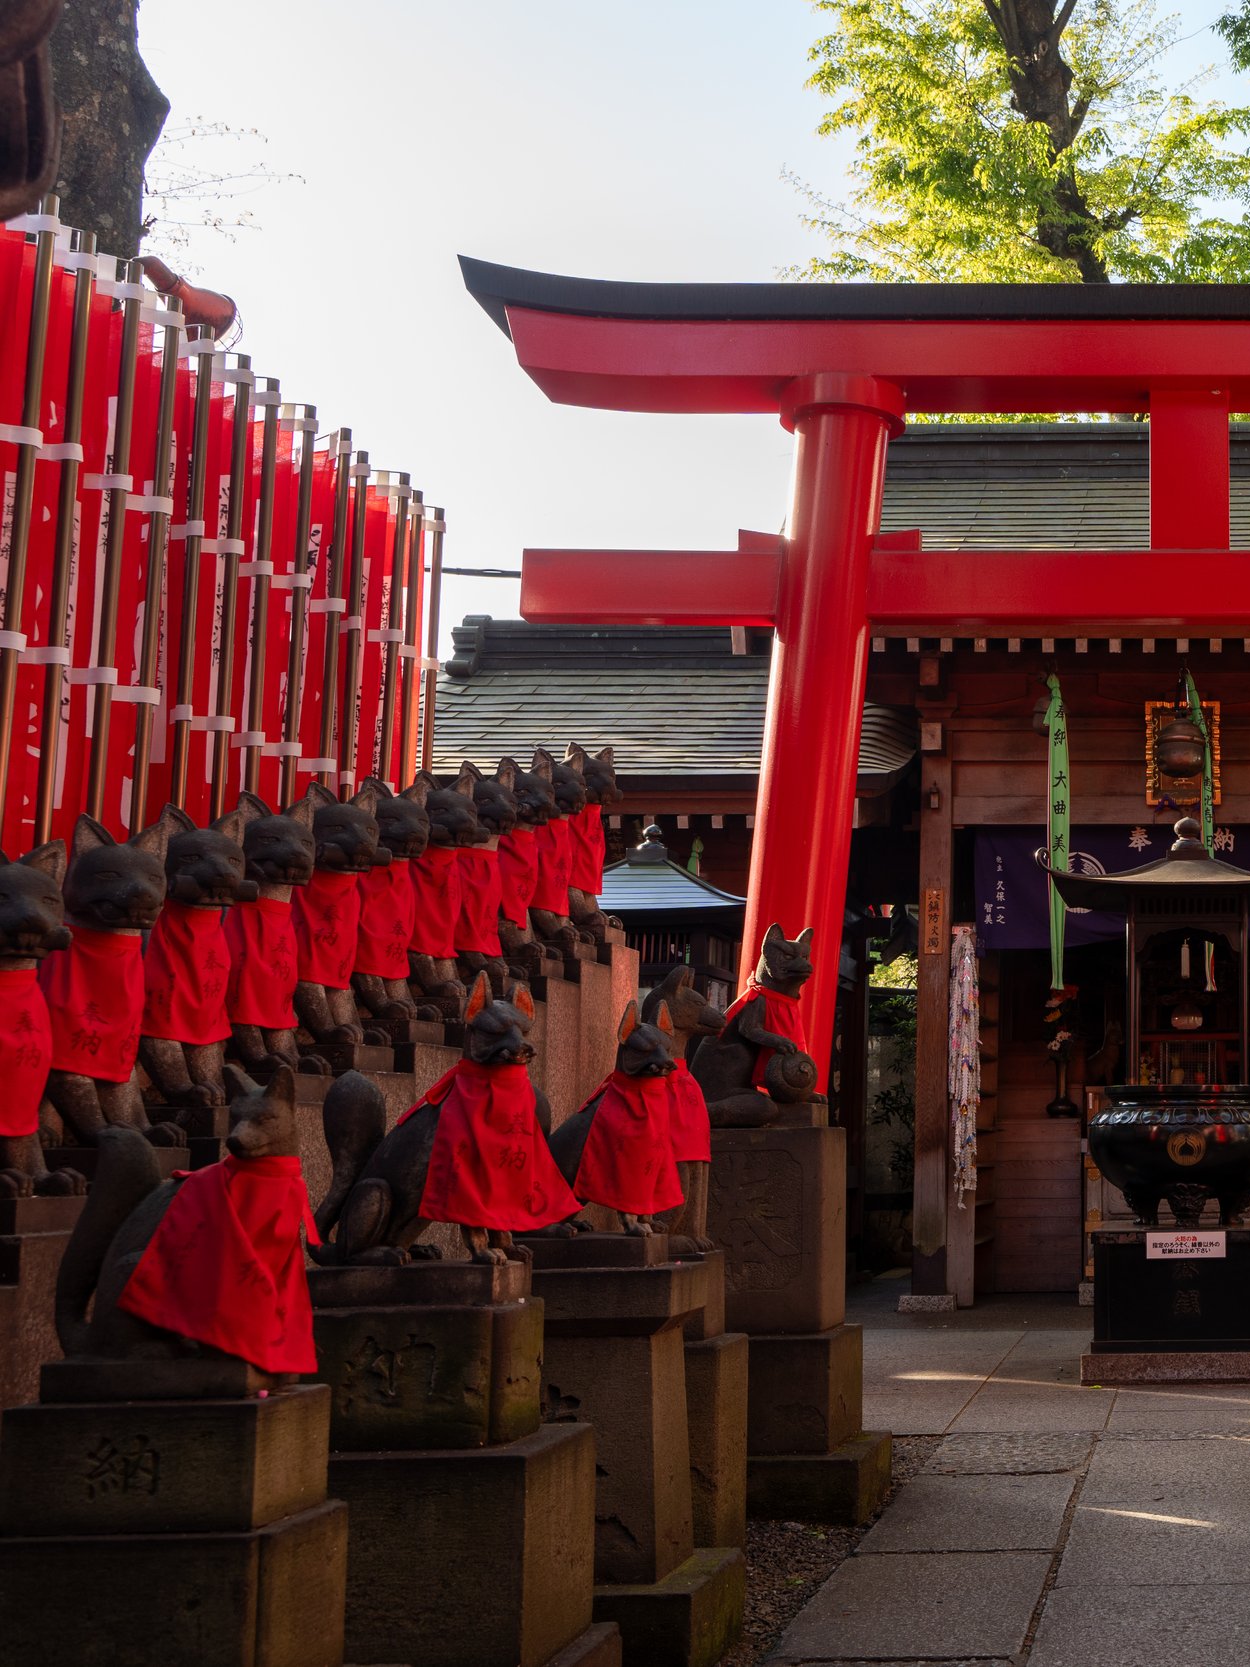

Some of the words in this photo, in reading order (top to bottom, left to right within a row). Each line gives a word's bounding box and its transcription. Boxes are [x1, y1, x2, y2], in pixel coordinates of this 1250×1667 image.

[984, 902, 993, 925] 智美
[996, 880, 1006, 924] 久保一之
[70, 1000, 112, 1056] 奉納
[498, 1112, 532, 1170] 奉納
[85, 1434, 160, 1503] 納
